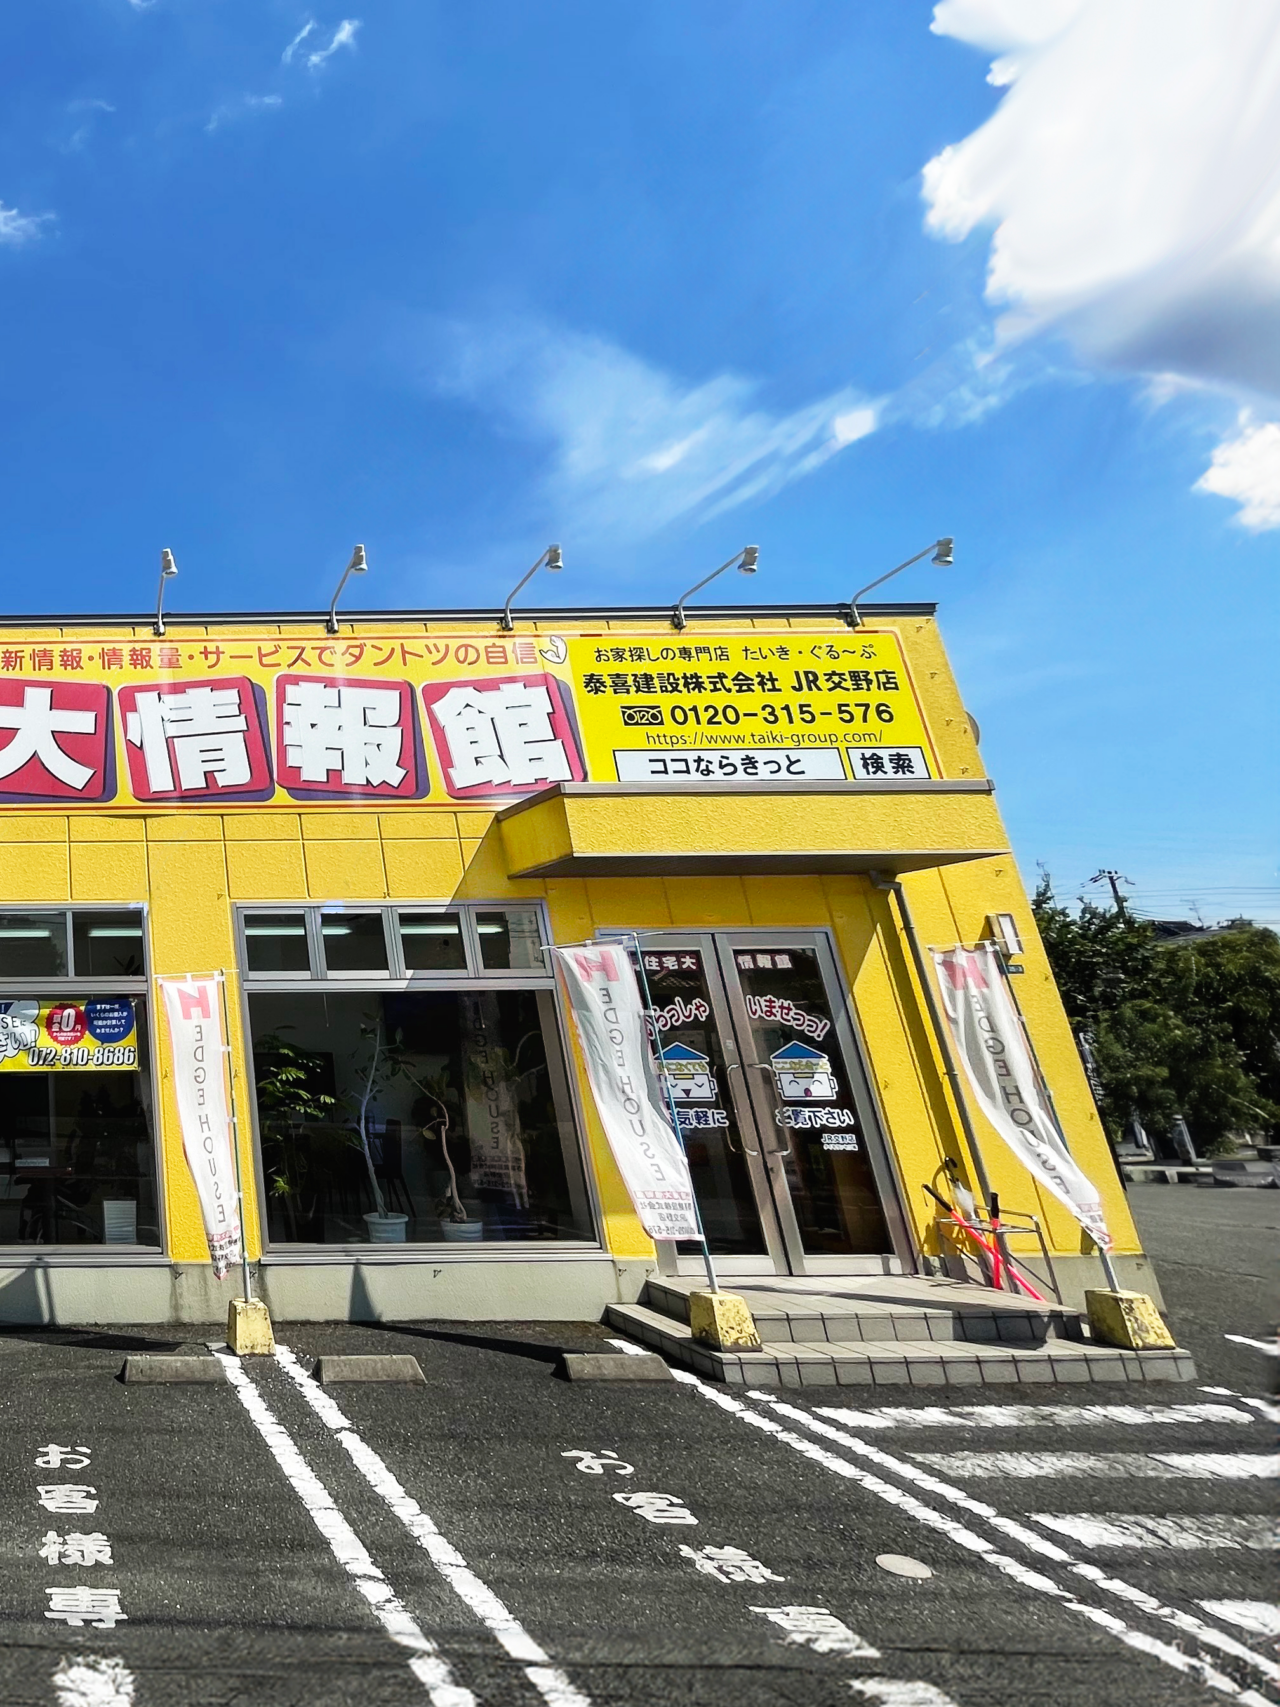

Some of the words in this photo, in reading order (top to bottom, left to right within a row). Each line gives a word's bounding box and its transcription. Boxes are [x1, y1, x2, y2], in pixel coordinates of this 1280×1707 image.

[594, 646, 731, 663] お家探しの専門店
[582, 671, 783, 695] 泰喜建設株式会社
[790, 670, 900, 693] JR交野店
[669, 702, 895, 726] 0120-315-576
[645, 729, 883, 747] https://www.taiki-group.com/
[648, 754, 807, 776] ココならきっと
[859, 752, 916, 776] 検索
[644, 954, 698, 970] 住宅大
[28, 1046, 136, 1067] 072-810-8686
[669, 1108, 730, 1128] 気軽に
